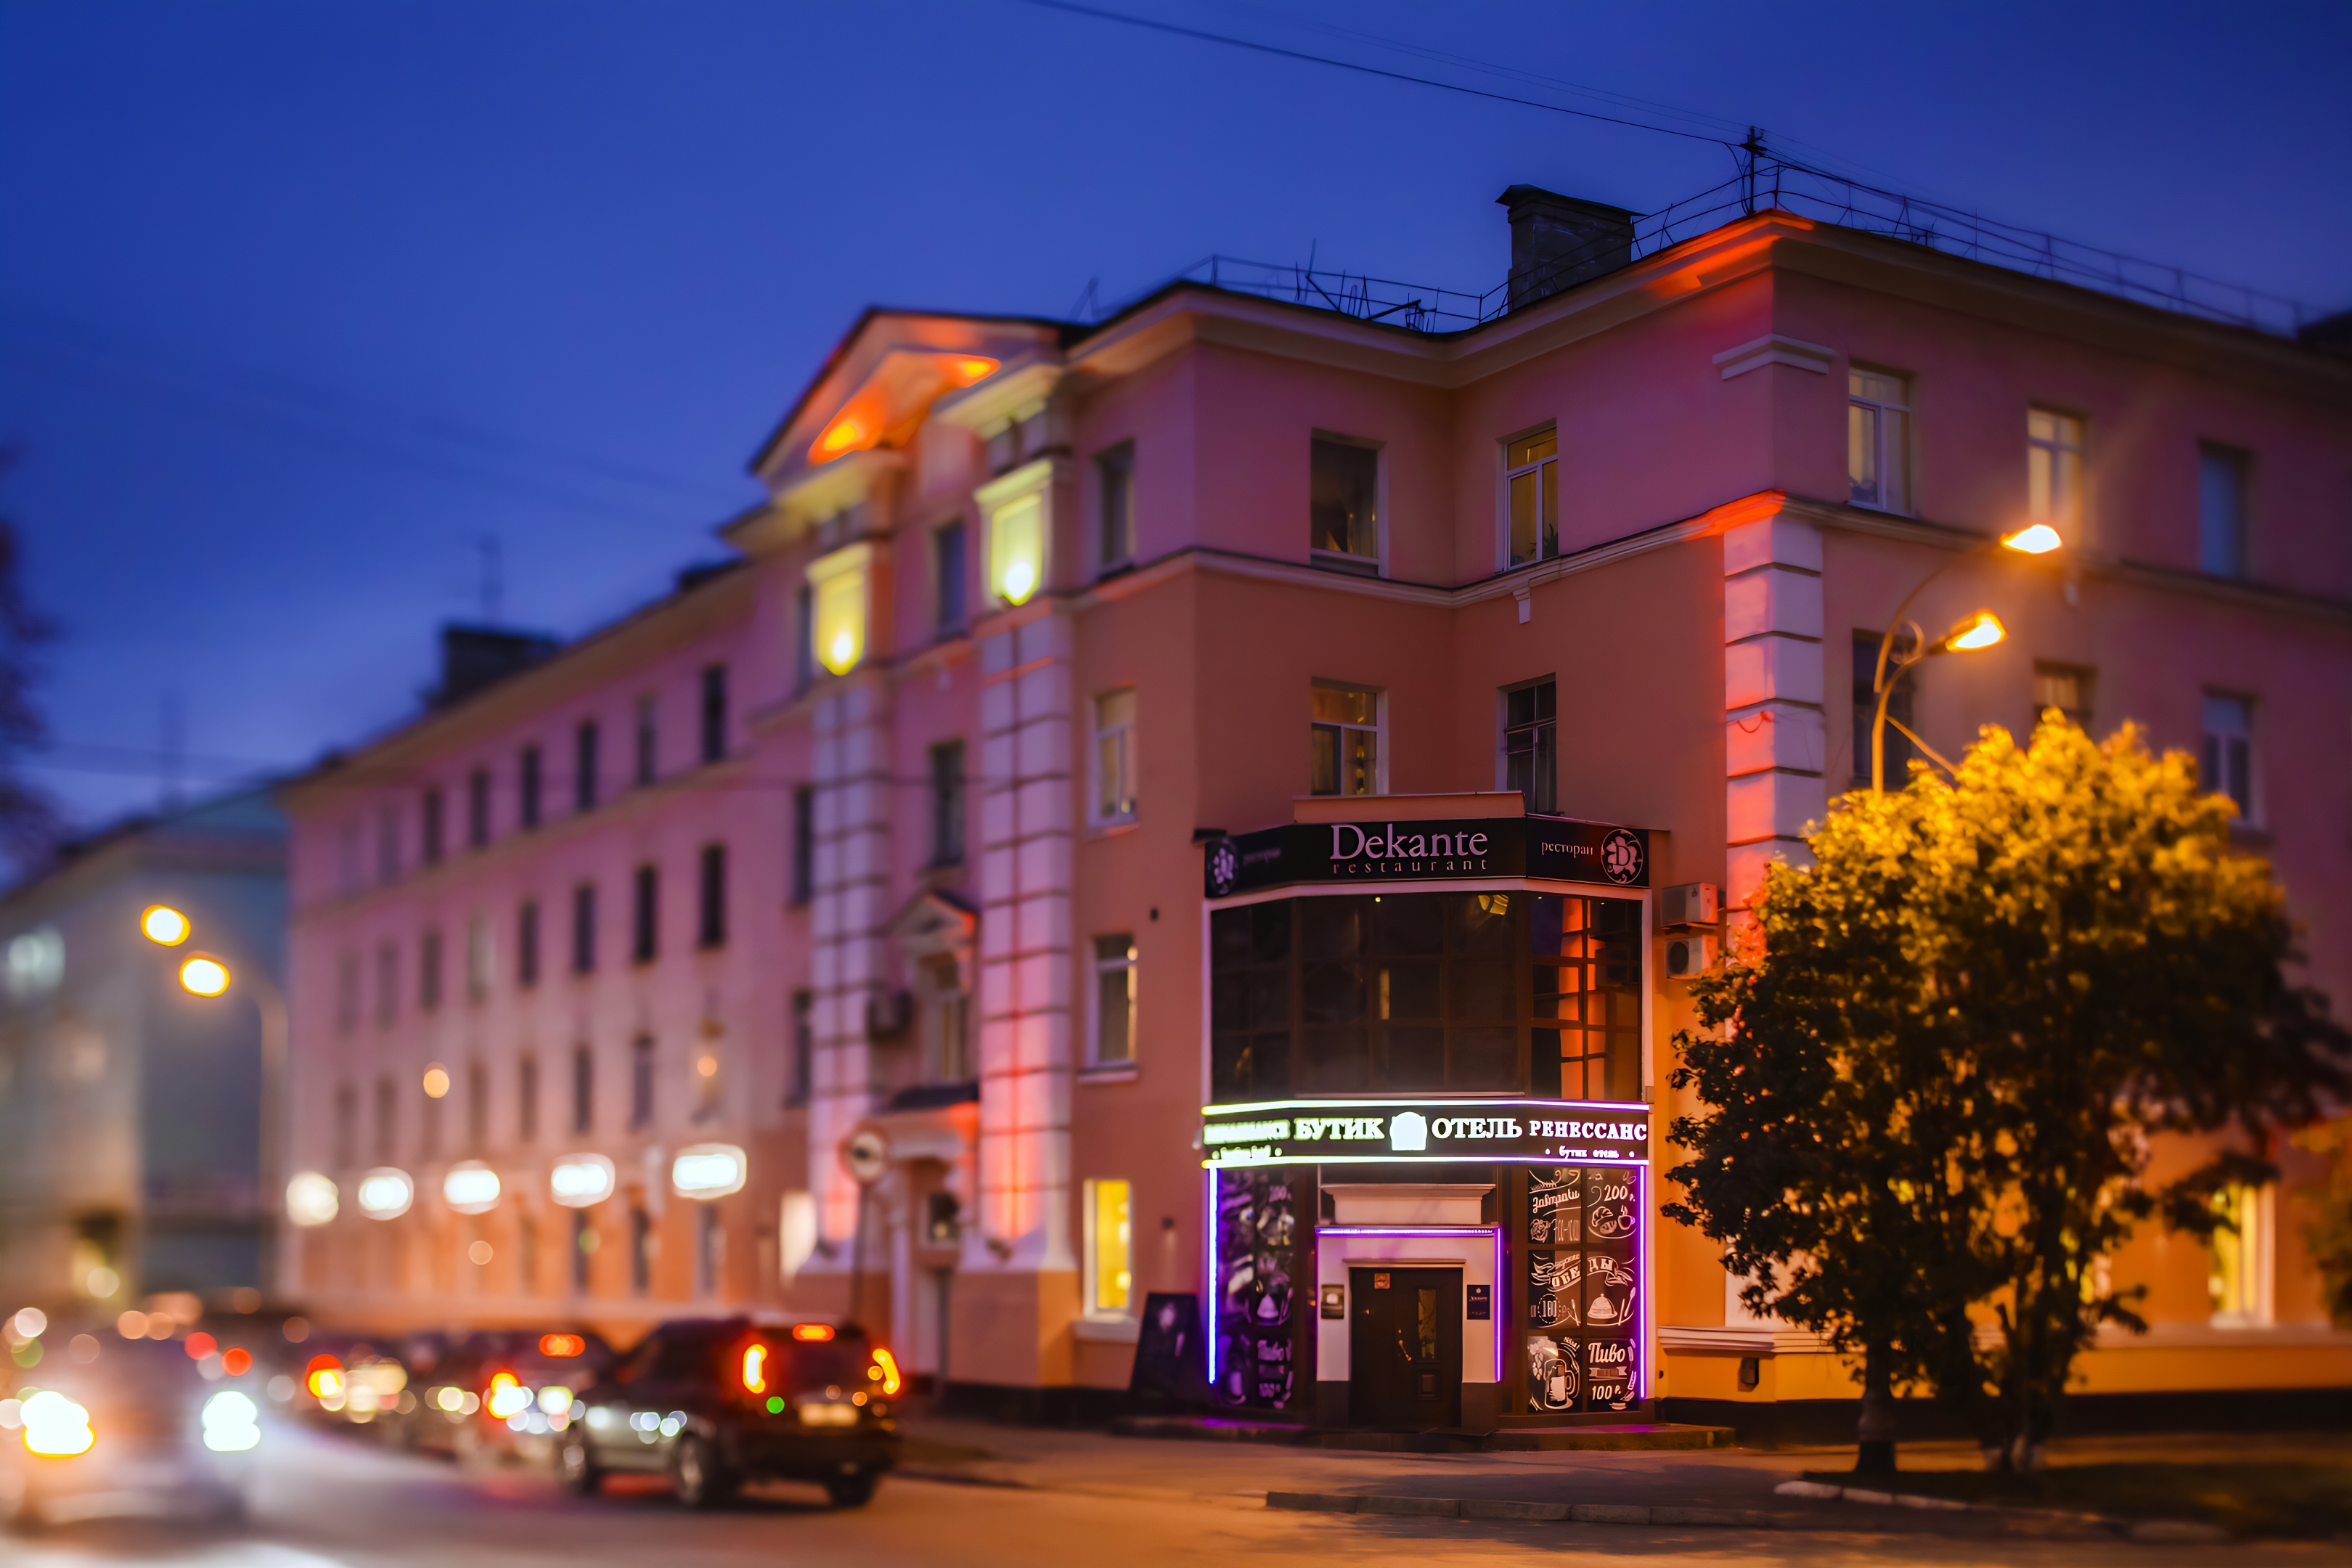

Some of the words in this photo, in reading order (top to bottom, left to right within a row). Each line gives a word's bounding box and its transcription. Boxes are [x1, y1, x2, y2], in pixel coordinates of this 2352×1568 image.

[1330, 822, 1488, 859] Dekante
[1541, 842, 1593, 858] ресторан
[1333, 859, 1487, 874] restaurant
[1294, 1118, 1385, 1140] БУТИК
[1432, 1118, 1523, 1139] ОТЕЛЬ
[1529, 1120, 1647, 1140] РЕНЕССАНС
[1604, 1185, 1628, 1201] 200
[1588, 1339, 1626, 1363] Пиво
[1592, 1385, 1612, 1400] 100
